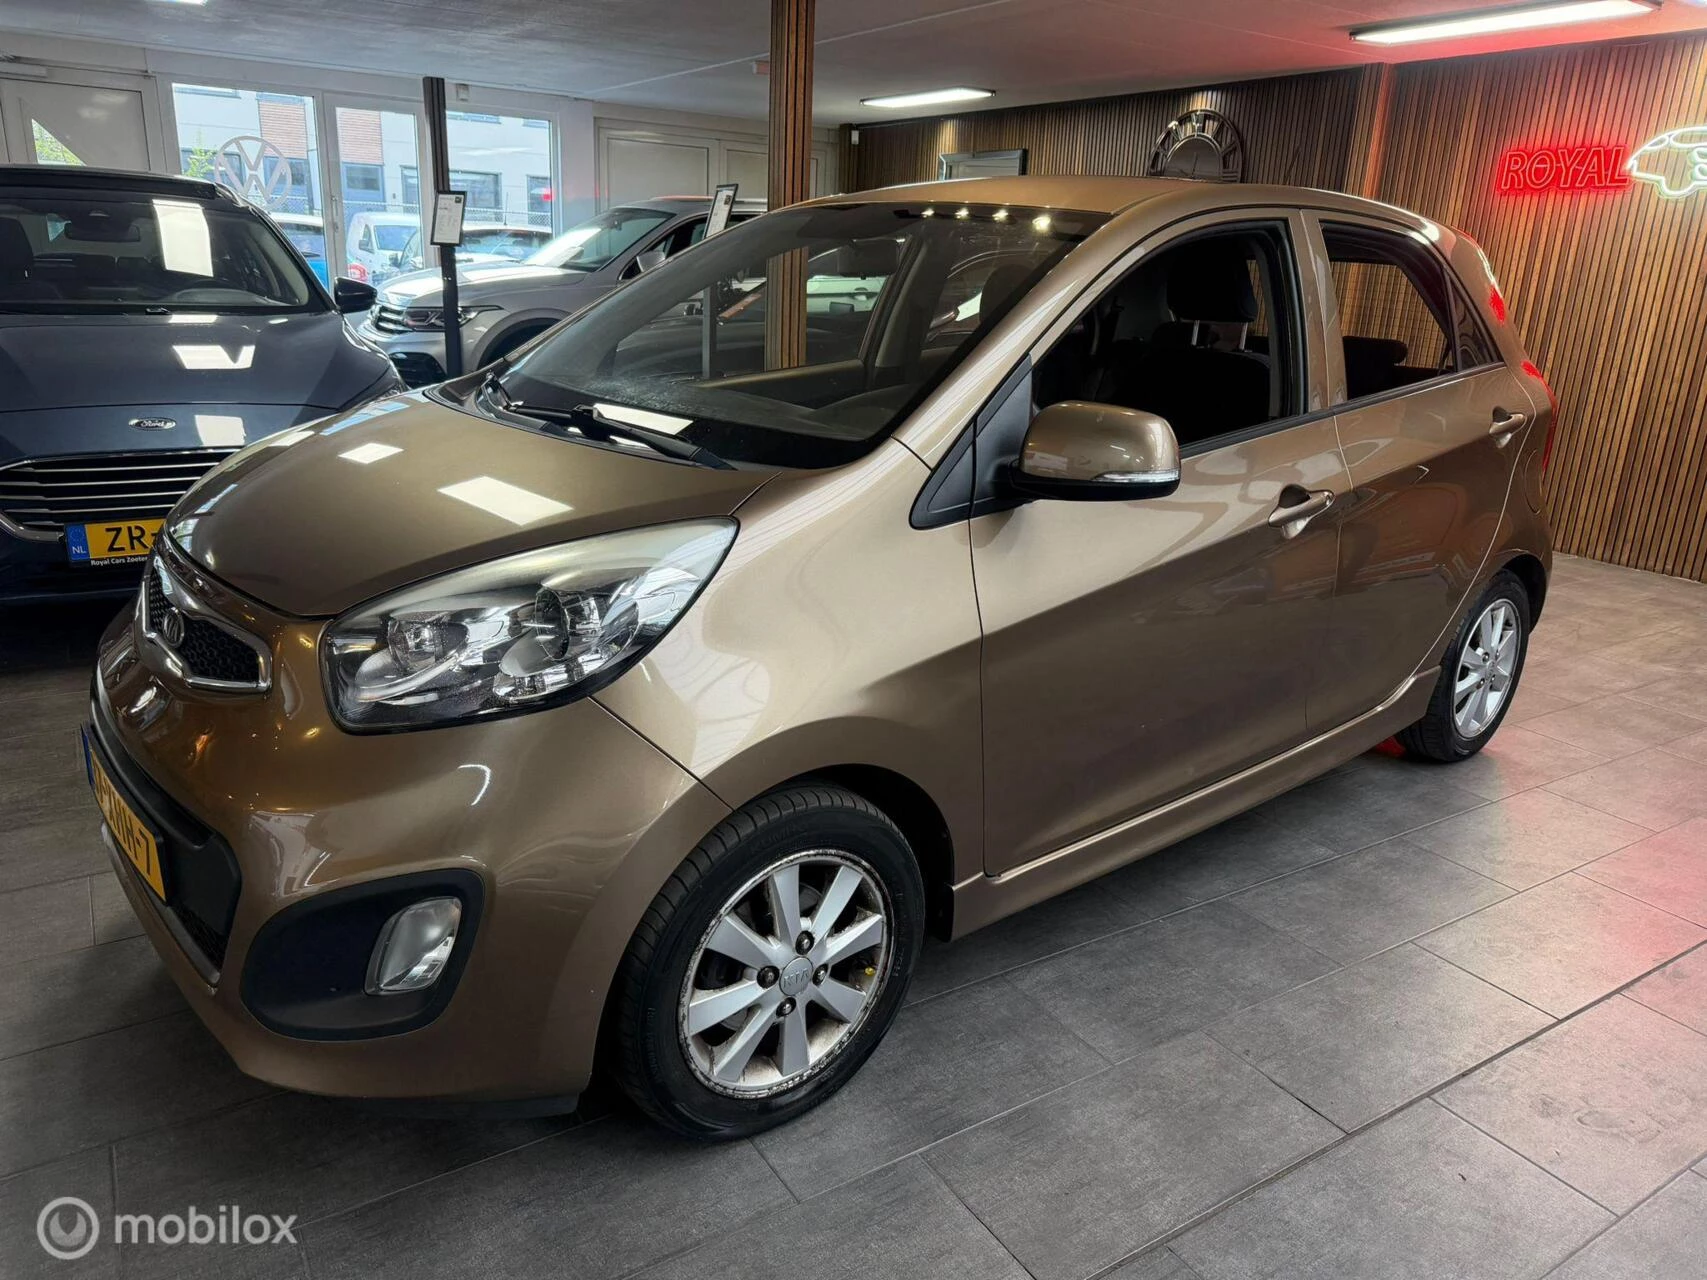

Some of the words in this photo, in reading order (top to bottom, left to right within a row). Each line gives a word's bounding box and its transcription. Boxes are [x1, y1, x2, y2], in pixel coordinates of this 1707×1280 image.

[1501, 146, 1630, 190] ROYAL
[72, 546, 87, 554] NL
[91, 559, 110, 567] Royal
[111, 557, 125, 565] Cars
[783, 967, 809, 989] KIA
